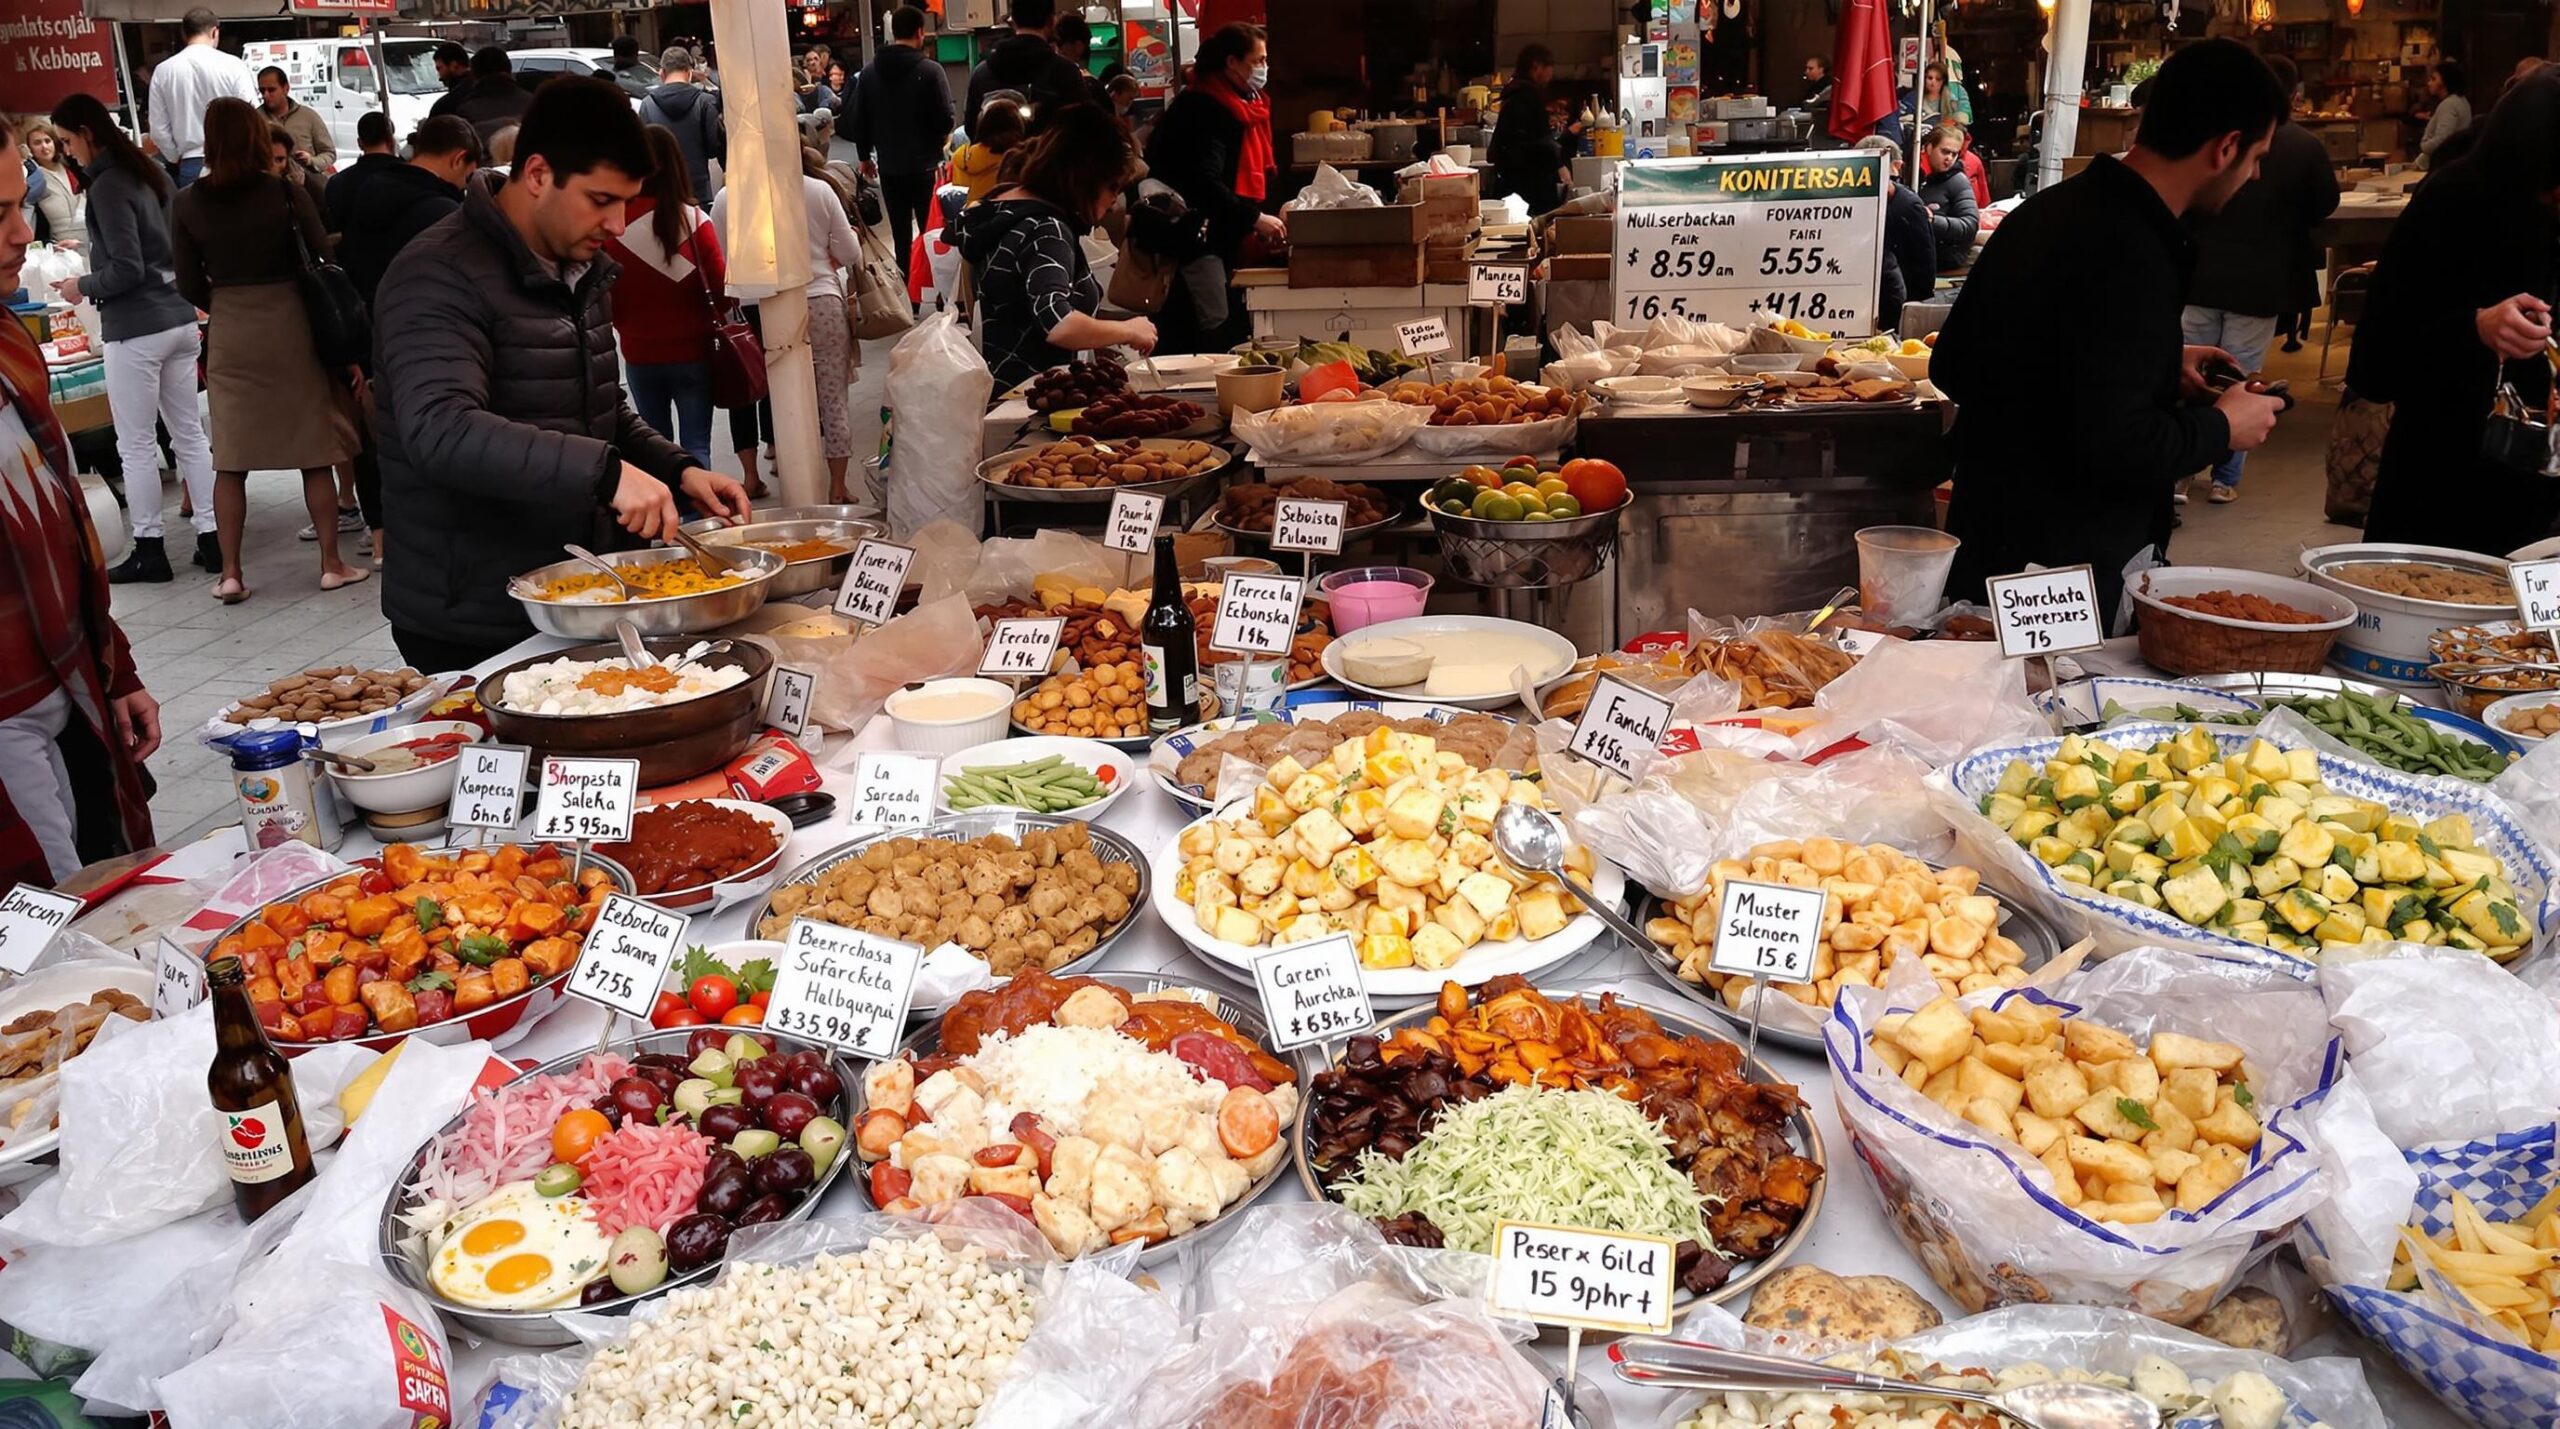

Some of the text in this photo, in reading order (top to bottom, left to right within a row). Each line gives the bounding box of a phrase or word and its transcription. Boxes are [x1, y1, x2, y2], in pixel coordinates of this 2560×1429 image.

[1720, 166, 1872, 192] KONITERSAA
[1767, 206, 1853, 221] FOVARTDON
[1650, 250, 1716, 278] 8.59
[1760, 247, 1824, 275] 5.55
[2525, 570, 2549, 593] Fur
[2003, 586, 2086, 609] Shorckata
[477, 755, 499, 773] Del
[1736, 892, 1800, 920] Muster
[1531, 1270, 1557, 1296] 15
